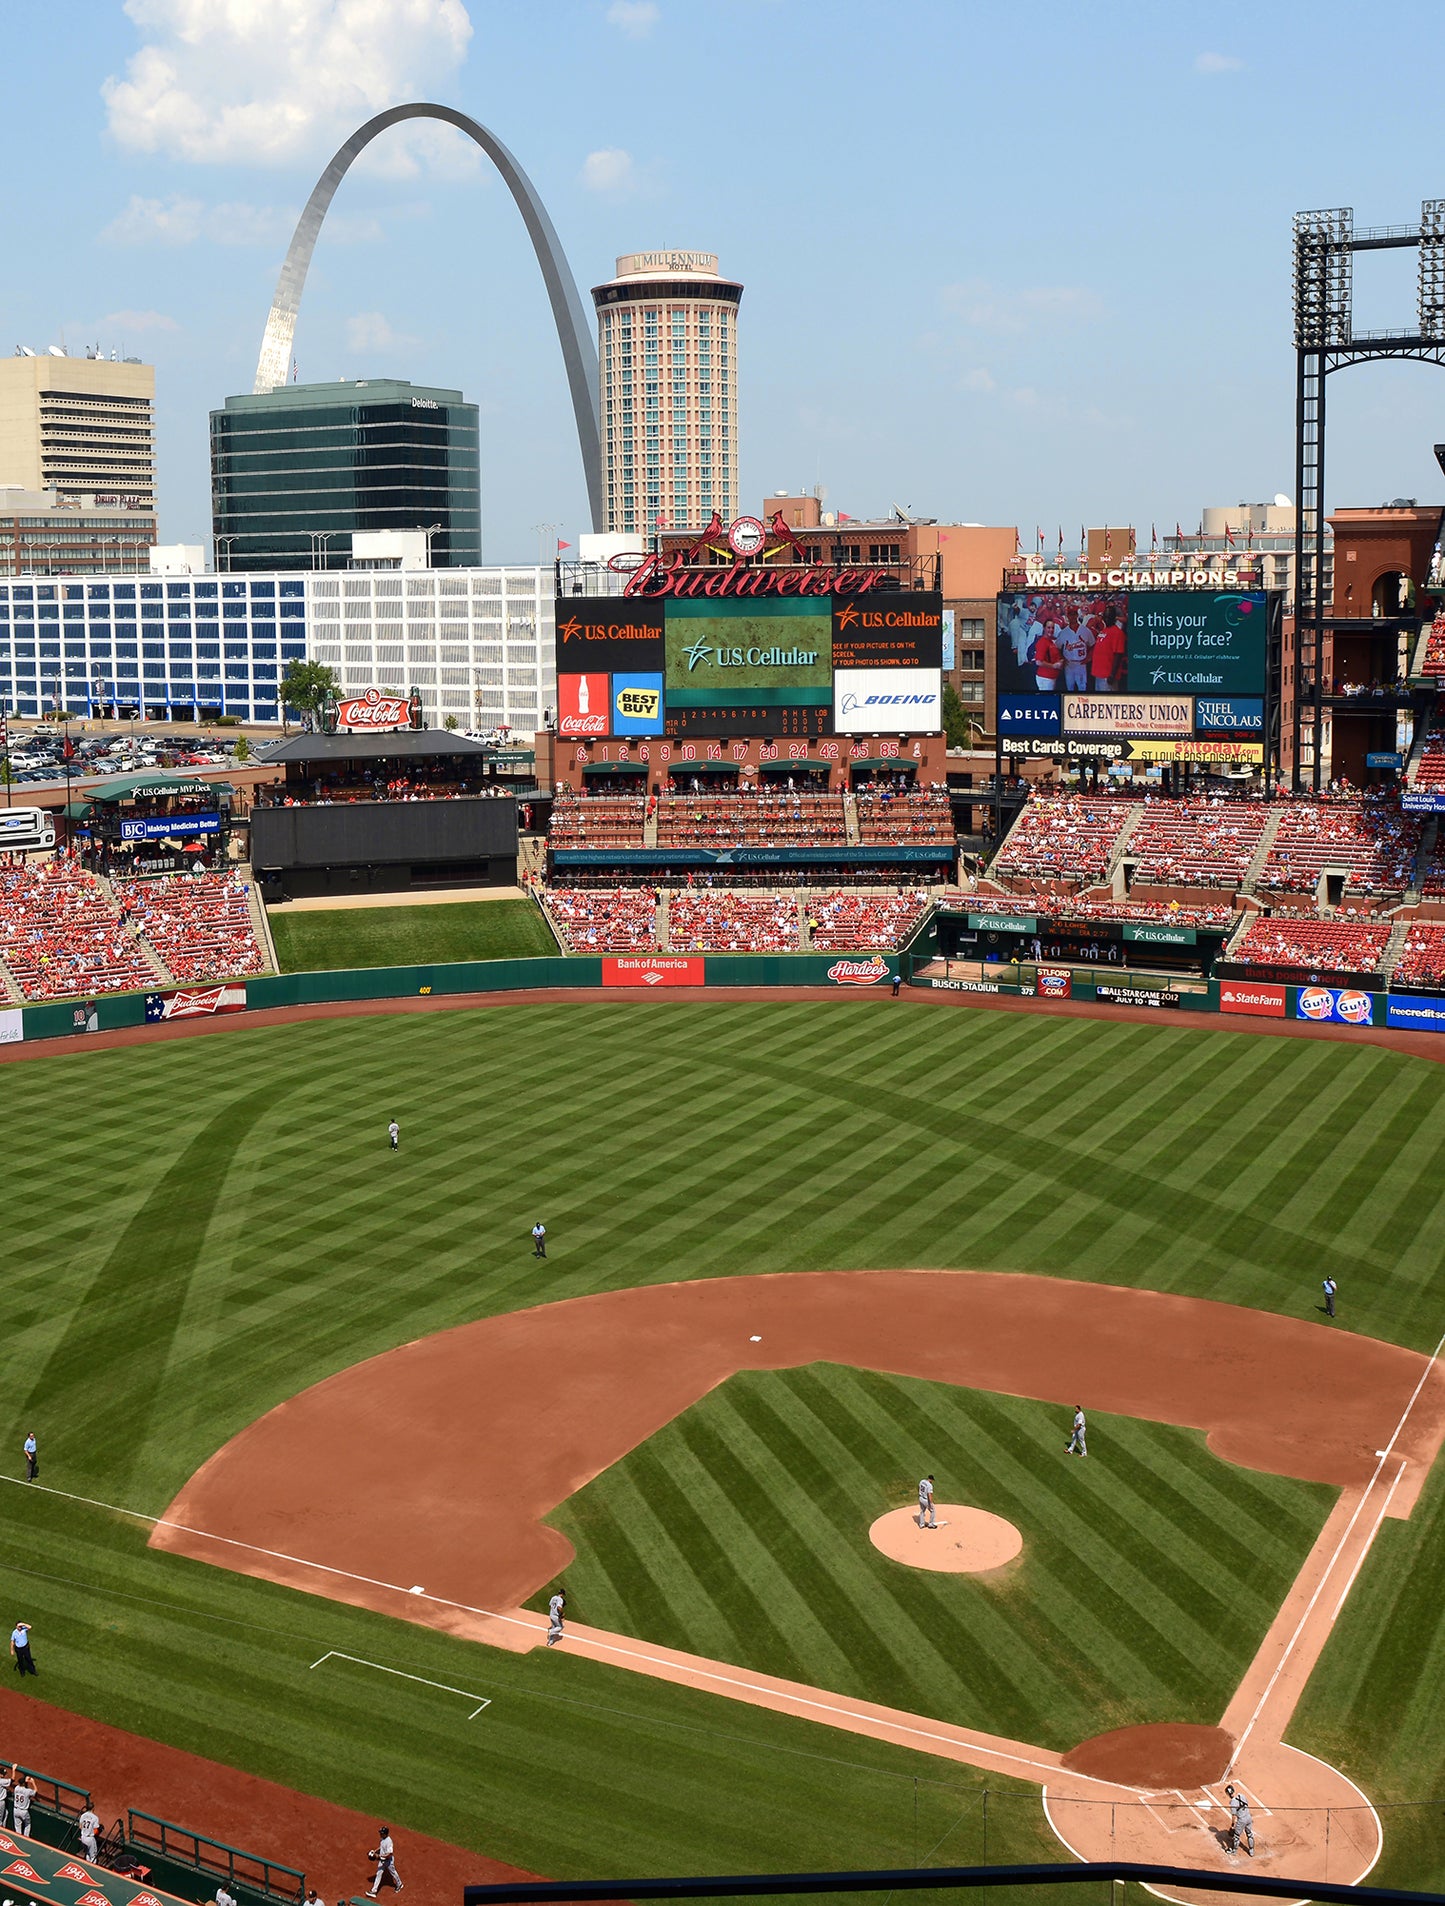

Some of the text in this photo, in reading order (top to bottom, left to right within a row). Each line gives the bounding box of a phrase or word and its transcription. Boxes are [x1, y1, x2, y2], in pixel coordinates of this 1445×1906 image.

[608, 550, 886, 598] Budweiser
[1026, 570, 1238, 587] WORLD CHAMPIONS
[862, 612, 940, 627] U.S. Cellular
[1133, 612, 1207, 630] Is this your
[584, 624, 662, 640] U.S. Cellular
[1150, 631, 1232, 649] happy face?
[716, 647, 817, 666] U.S. Cellular
[1184, 672, 1223, 684] Cellular
[622, 694, 658, 704] BEST
[864, 695, 936, 704] BOEING
[346, 701, 402, 724] Coca-Cola
[624, 704, 654, 714] BUY
[1068, 702, 1188, 720] CARPENTERS' UNION
[1198, 702, 1233, 714] STIFEL
[1015, 710, 1058, 720] DELTA
[1203, 714, 1262, 726] NICOLAUS
[561, 715, 607, 732] Coca-Cola
[602, 747, 608, 760] 1
[618, 746, 628, 760] 2
[640, 746, 650, 760] 6
[660, 746, 670, 760] 9
[682, 746, 696, 760] 10
[707, 745, 722, 760] 14
[733, 745, 748, 759] 17
[760, 744, 778, 759] 20
[789, 744, 808, 758] 24
[820, 744, 838, 758] 42
[850, 744, 868, 758] 45
[880, 743, 898, 758] 85
[1002, 739, 1122, 758] Best Cards Coverage
[1155, 752, 1180, 761] LOUIS
[1184, 752, 1252, 763] POST-DISPATCH
[154, 786, 178, 795] Cellular
[1402, 802, 1432, 810] University
[124, 824, 144, 836] BJC
[171, 822, 198, 830] Medicine
[1000, 921, 1026, 930] Cellular
[1157, 933, 1185, 942] Cellular
[618, 959, 688, 968] Bank of America
[1246, 968, 1273, 978] that's
[932, 979, 998, 992] BUSCH STADIUM
[1045, 978, 1062, 986] Ford
[1044, 988, 1063, 996] .COM
[1140, 991, 1160, 999] GAME
[1303, 997, 1330, 1008] Gulf
[1340, 1000, 1367, 1012] Gulf
[74, 1010, 85, 1022] 10
[16, 1795, 24, 1803] 56
[82, 1820, 91, 1828] 27
[14, 1864, 33, 1877] 1930
[66, 1866, 86, 1880] 1943
[86, 1894, 108, 1906] 1968
